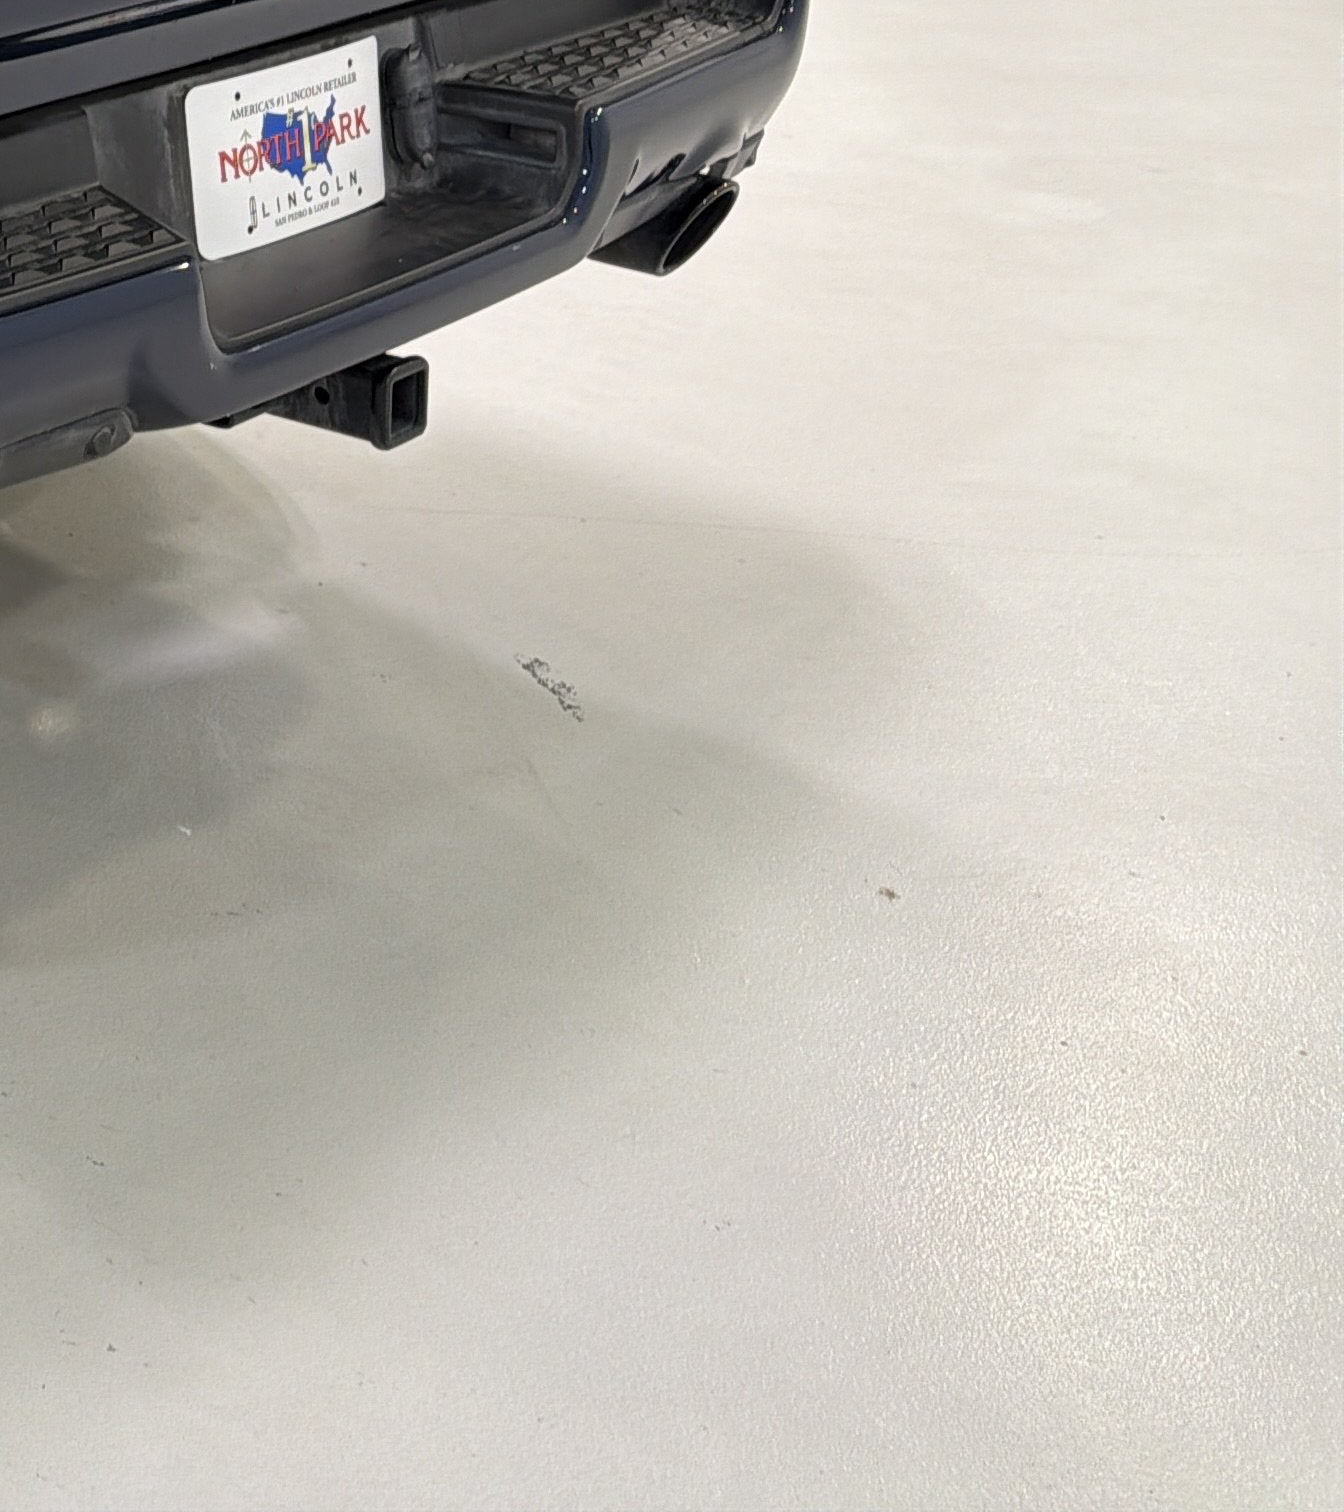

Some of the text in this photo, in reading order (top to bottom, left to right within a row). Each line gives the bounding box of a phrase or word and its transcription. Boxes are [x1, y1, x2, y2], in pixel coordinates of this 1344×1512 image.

[230, 98, 276, 122] AMERICA'S
[286, 85, 323, 104] LINCOLN
[323, 71, 357, 92] RETAILER
[218, 105, 371, 183] NORTH PARK
[261, 168, 358, 218] LINCOLN
